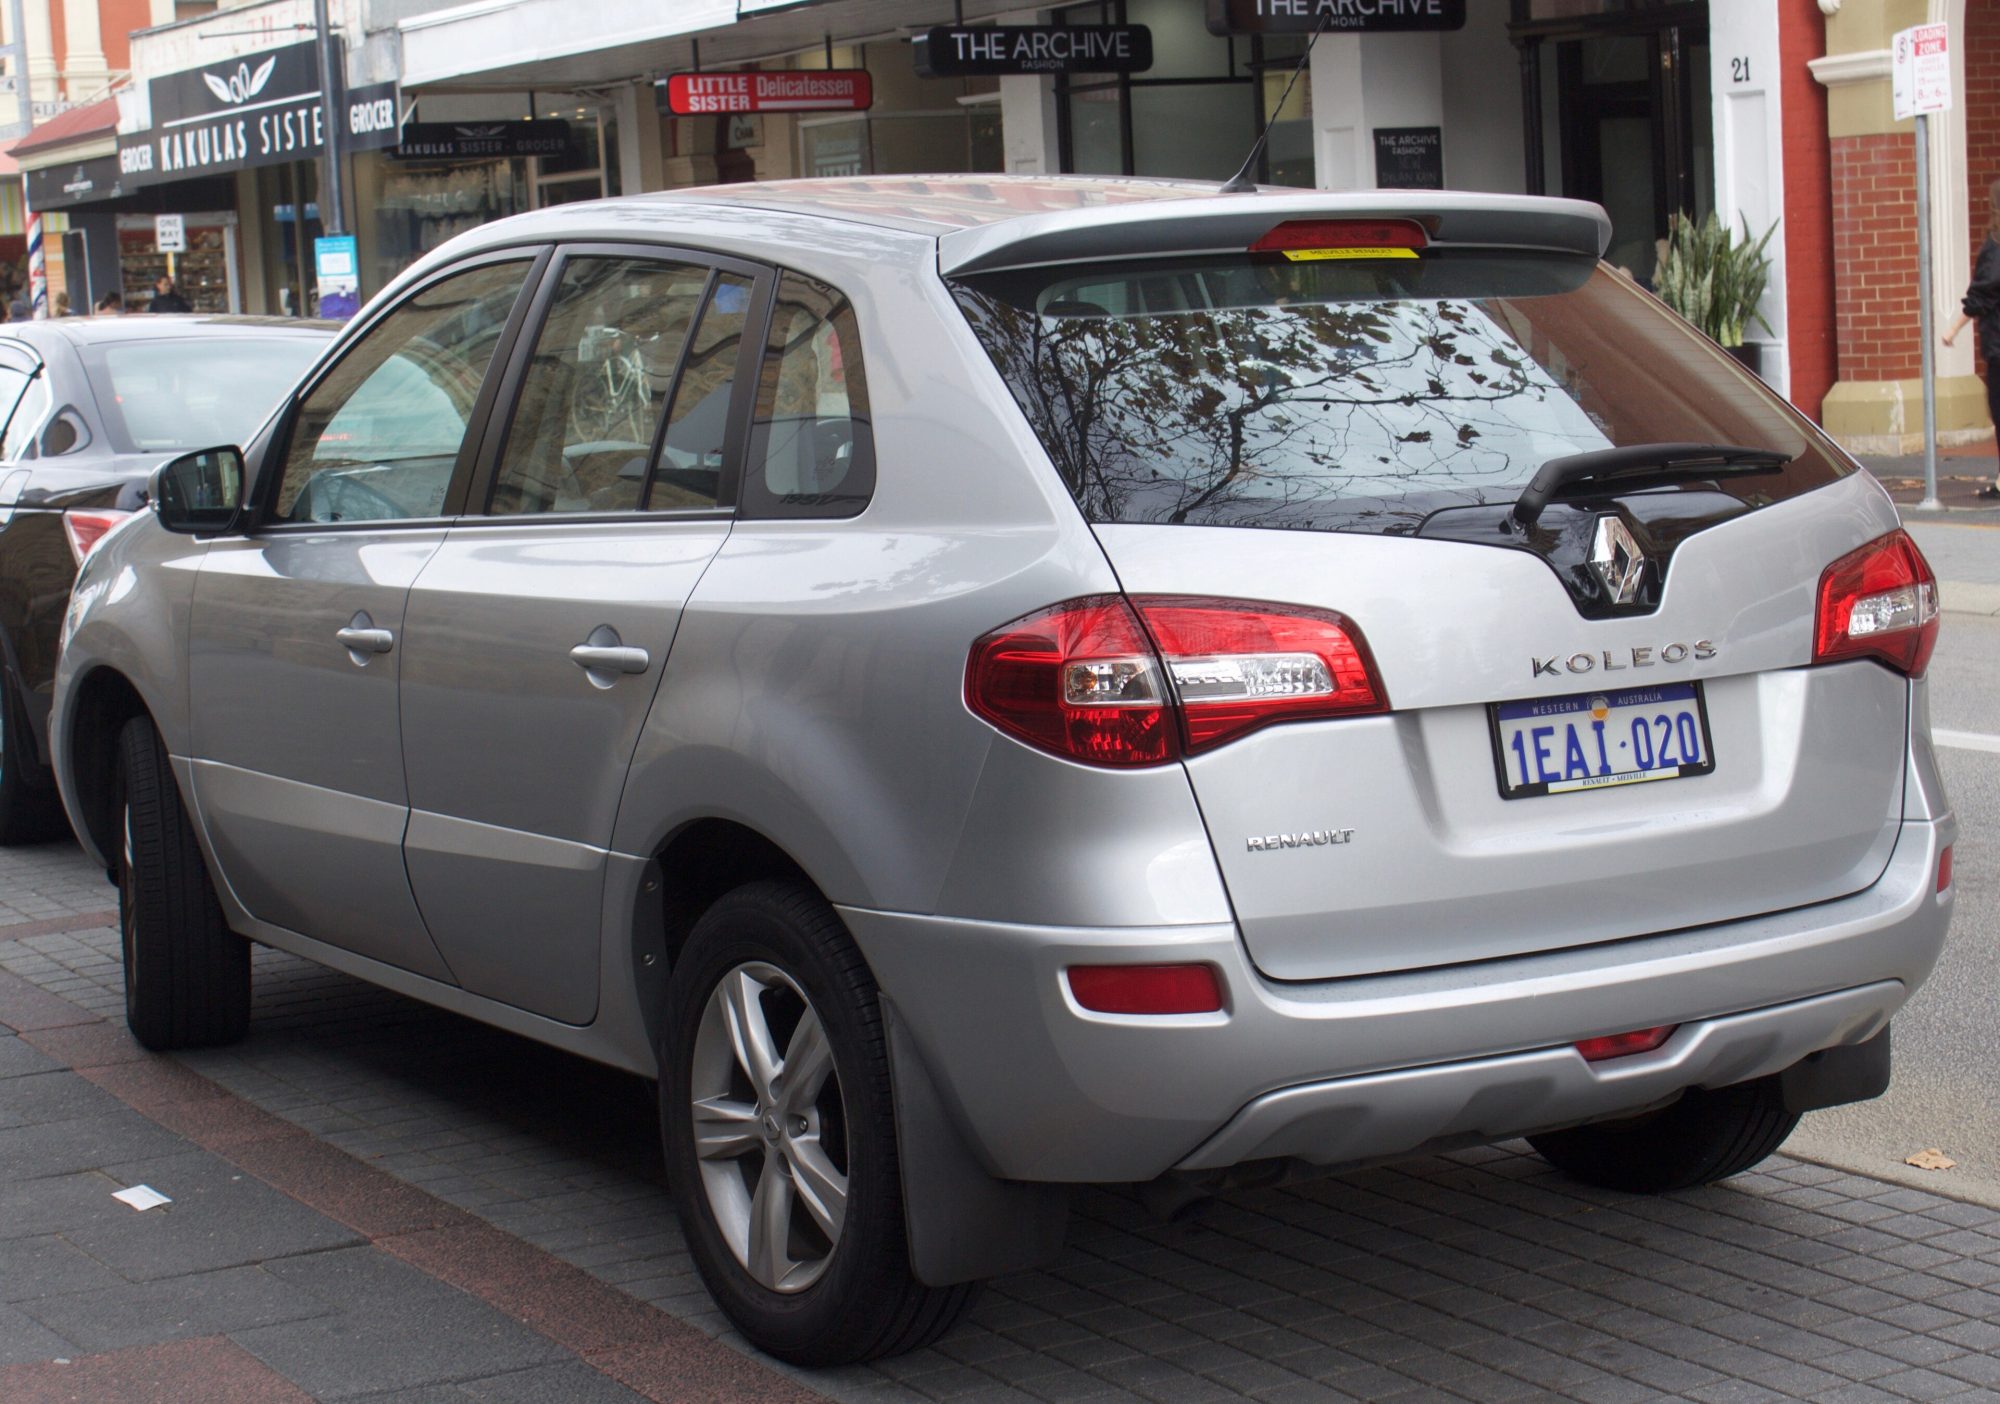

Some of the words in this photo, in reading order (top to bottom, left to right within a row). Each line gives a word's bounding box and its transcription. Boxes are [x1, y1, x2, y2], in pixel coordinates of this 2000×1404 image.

[1254, 0, 1308, 15] THE
[1315, 0, 1442, 15] ARCHIVE
[1331, 16, 1365, 27] HOME
[1914, 26, 1946, 41] LOADING
[951, 33, 1006, 60] THE
[1012, 31, 1131, 59] ARCHIVE
[1919, 39, 1941, 54] ZONE
[1021, 60, 1064, 70] FASHION
[1731, 56, 1750, 82] 21
[687, 76, 748, 94] LITTLE
[756, 76, 854, 97] Delicatessen
[689, 95, 750, 112] SISTER
[350, 98, 394, 134] GROCER
[160, 120, 247, 171] KAKULAS
[260, 106, 323, 154] SISTE
[1380, 136, 1396, 146] THE
[1398, 135, 1438, 145] ARCHIVE
[399, 142, 454, 155] KAKULAS
[460, 140, 501, 153] SISTER
[517, 139, 565, 151] GROCER
[1392, 146, 1426, 155] FASHION
[120, 144, 152, 174] GROCER
[160, 219, 178, 228] ONE
[1531, 640, 1717, 678] KOLEOS
[1532, 701, 1579, 715] WESTERN
[1618, 692, 1663, 705] AUSTRALIA
[1583, 776, 1611, 786] RENAULT
[1617, 772, 1647, 781] MELVILLE
[1247, 828, 1355, 852] RENAULT
